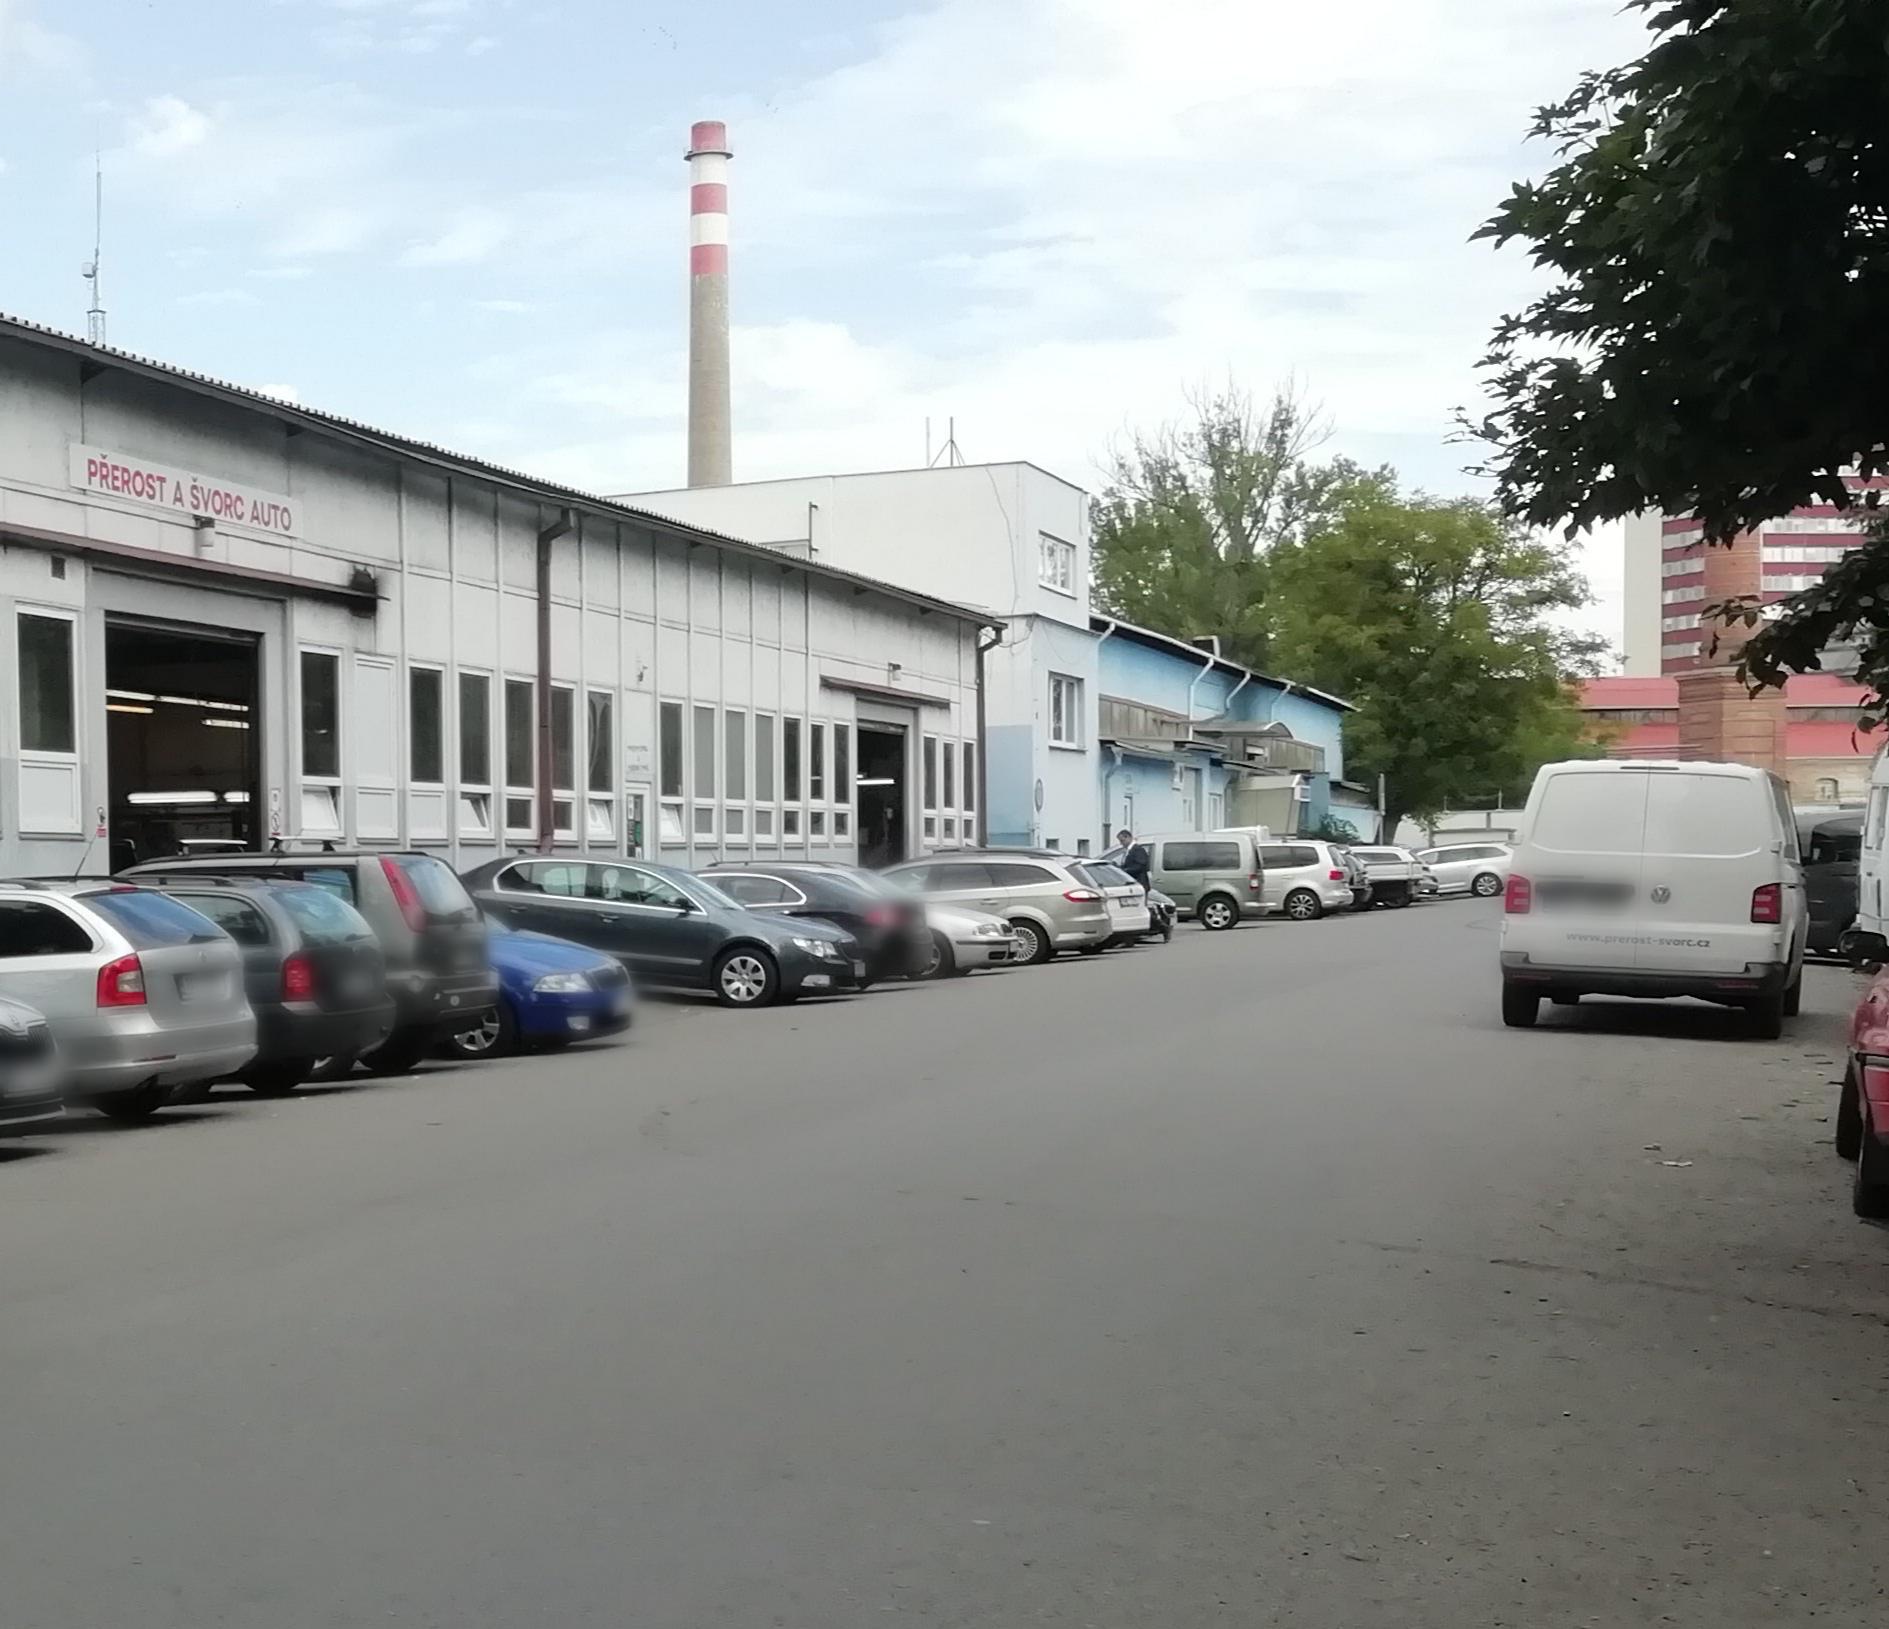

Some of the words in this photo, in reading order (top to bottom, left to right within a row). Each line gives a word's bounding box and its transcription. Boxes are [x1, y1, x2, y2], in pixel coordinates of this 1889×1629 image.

[87, 453, 167, 503] PŘEROST
[172, 480, 185, 508] A
[190, 477, 245, 521] ŠVORC
[250, 500, 292, 532] AUTO
[1566, 932, 1711, 949] www.prerost-svorc.cz
